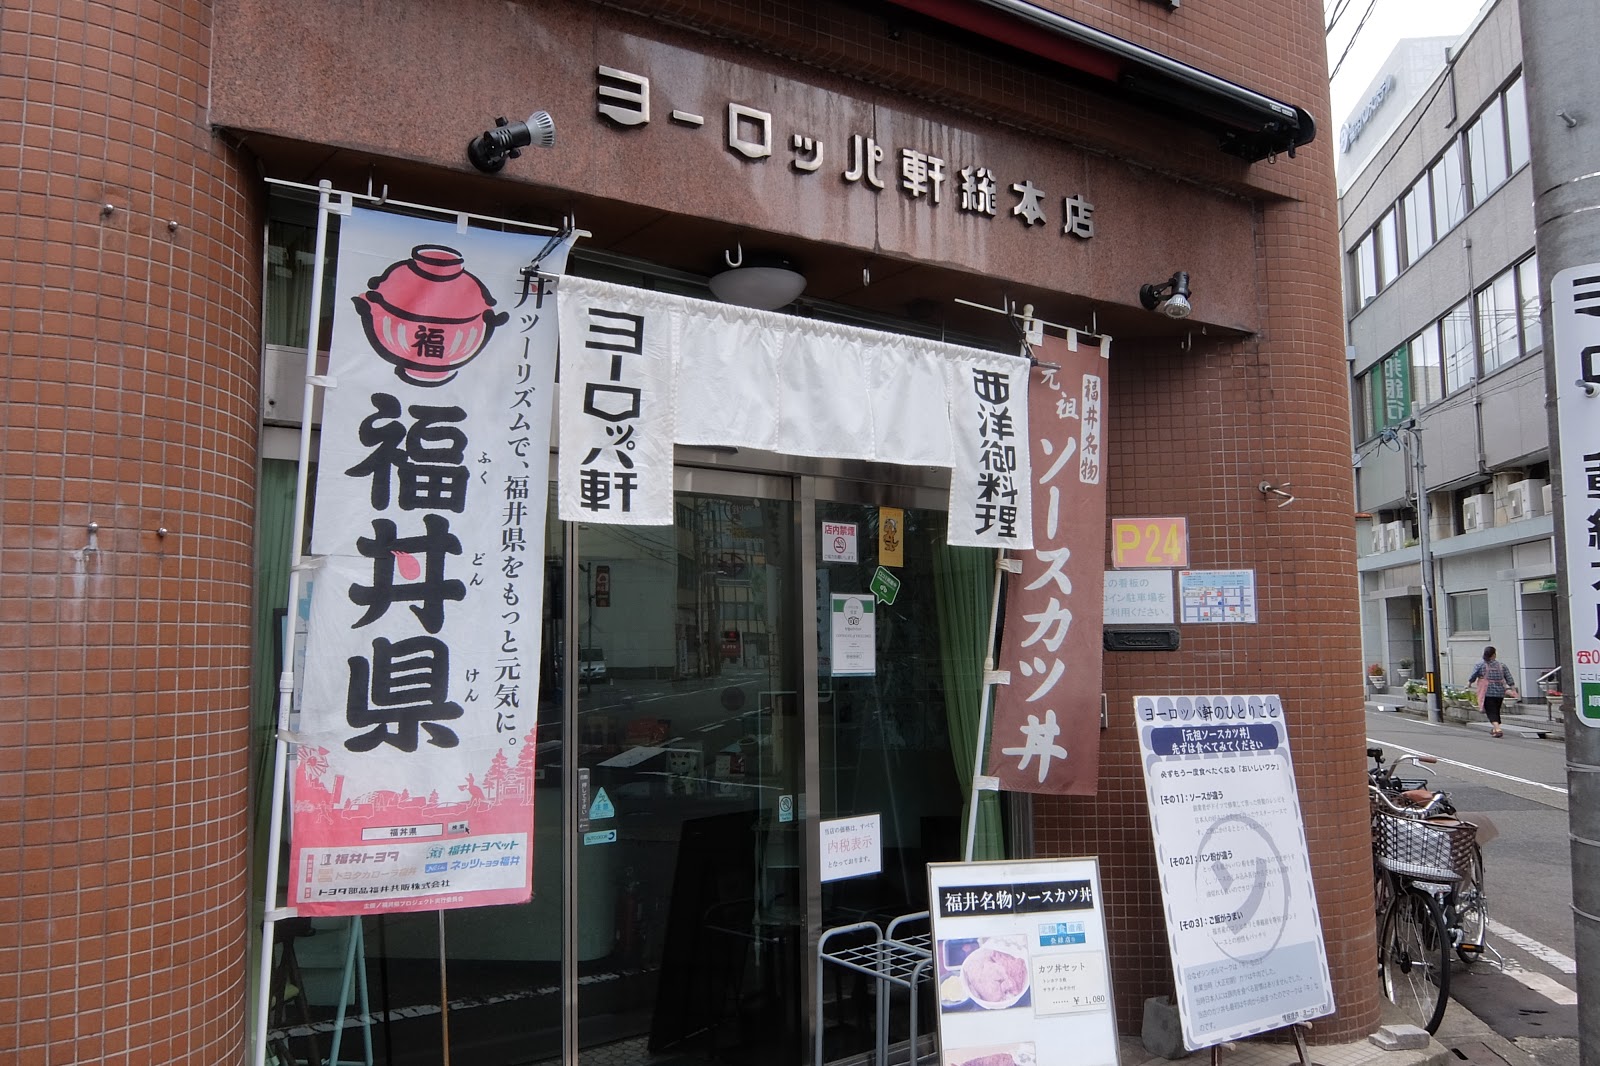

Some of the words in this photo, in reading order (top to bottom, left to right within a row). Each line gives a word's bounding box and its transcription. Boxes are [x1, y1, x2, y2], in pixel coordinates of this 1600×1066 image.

[598, 65, 1095, 239] ヨーロッパ軒総本店
[412, 325, 445, 358] 福
[580, 308, 644, 512] ヨーロッパ軒
[1080, 379, 1099, 481] 福井名物
[478, 451, 492, 485] ふく
[972, 367, 1018, 538] 西洋御料理
[824, 524, 855, 536] 店内禁煙
[1116, 523, 1181, 563] P24
[344, 392, 470, 753] 福丼県
[469, 552, 485, 587] どん
[1002, 436, 1077, 784] ソースカツ丼
[465, 668, 481, 703] けん
[335, 851, 400, 865] 福井トヨタ
[448, 840, 519, 856] 福井トヨペット
[827, 834, 873, 855] 内税表示
[450, 855, 521, 870] ネッツトヨタ福井
[318, 879, 450, 896] トヨタ部品福井共販株式会社
[944, 890, 1013, 912] 福井名物
[1015, 886, 1092, 905] ソースカツ丼
[1038, 962, 1085, 974] カツ丼セット
